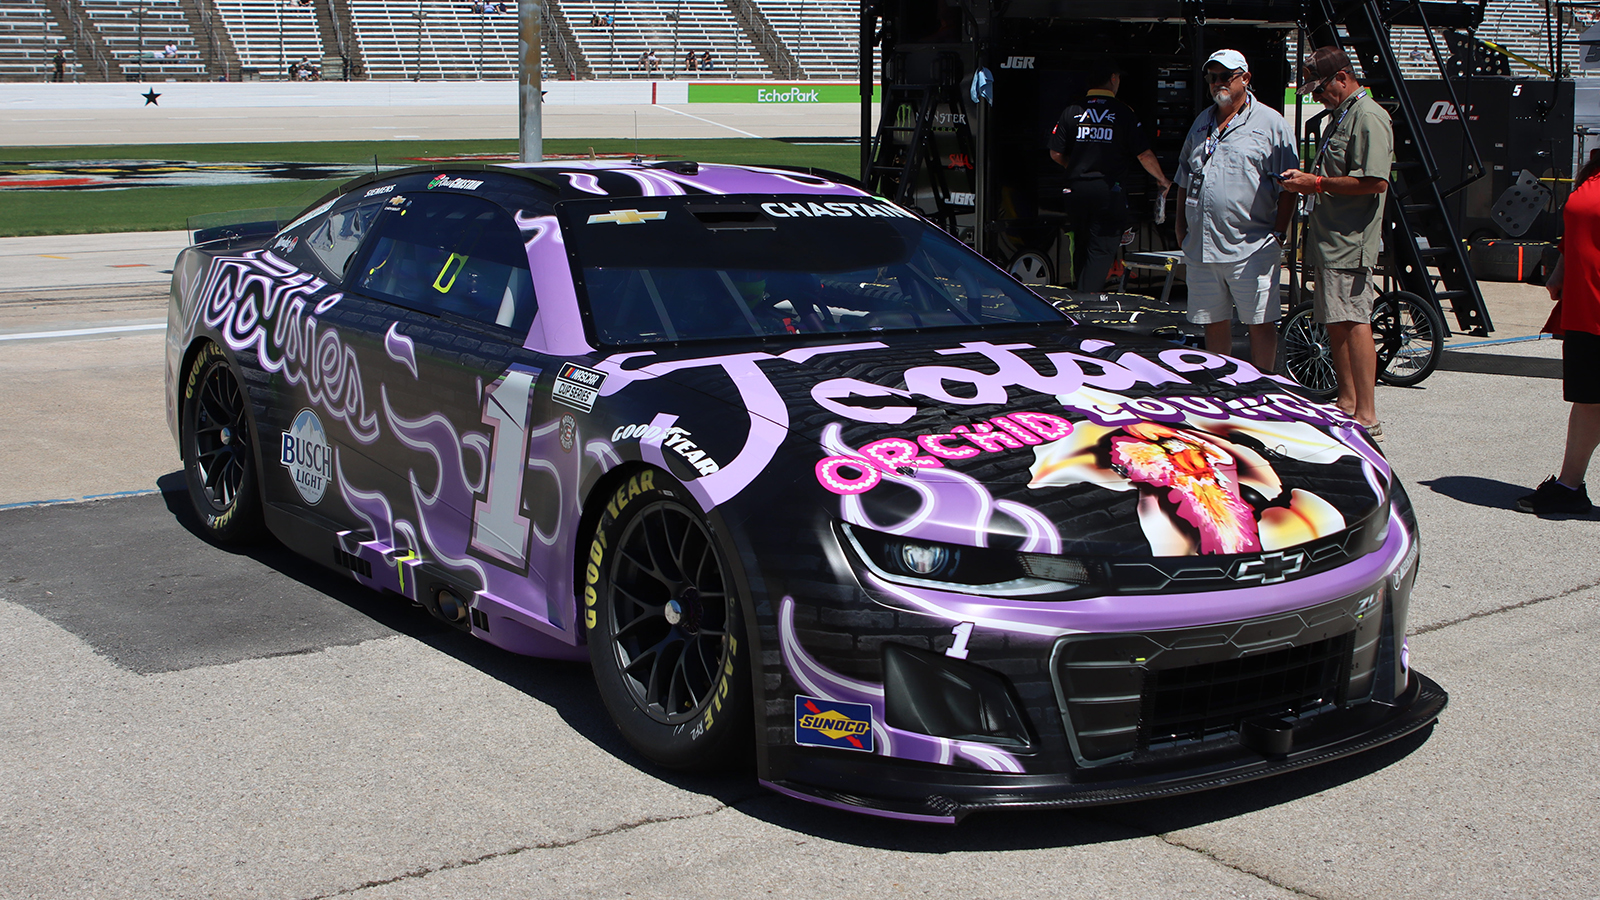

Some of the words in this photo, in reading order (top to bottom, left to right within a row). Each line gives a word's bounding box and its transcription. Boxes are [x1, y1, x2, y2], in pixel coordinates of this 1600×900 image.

[1000, 56, 1035, 69] JGR
[757, 87, 819, 102] EchoPark
[1512, 84, 1523, 97] 5
[1075, 126, 1113, 141] JP300
[363, 184, 397, 198] SIEMENS
[944, 192, 975, 206] JGR
[760, 201, 916, 220] CHASTAIN
[570, 368, 600, 386] NASCAR
[558, 383, 571, 396] CUP
[570, 386, 592, 403] SERIES
[283, 433, 332, 479] BUSCH
[816, 412, 1074, 494] ORCHID
[296, 468, 323, 491] LIGHT
[470, 362, 543, 577] 1
[584, 468, 656, 630] GOODYEAR
[944, 621, 975, 660] 1
[704, 632, 738, 731] EAGLE
[800, 714, 868, 735] SUNOCO
